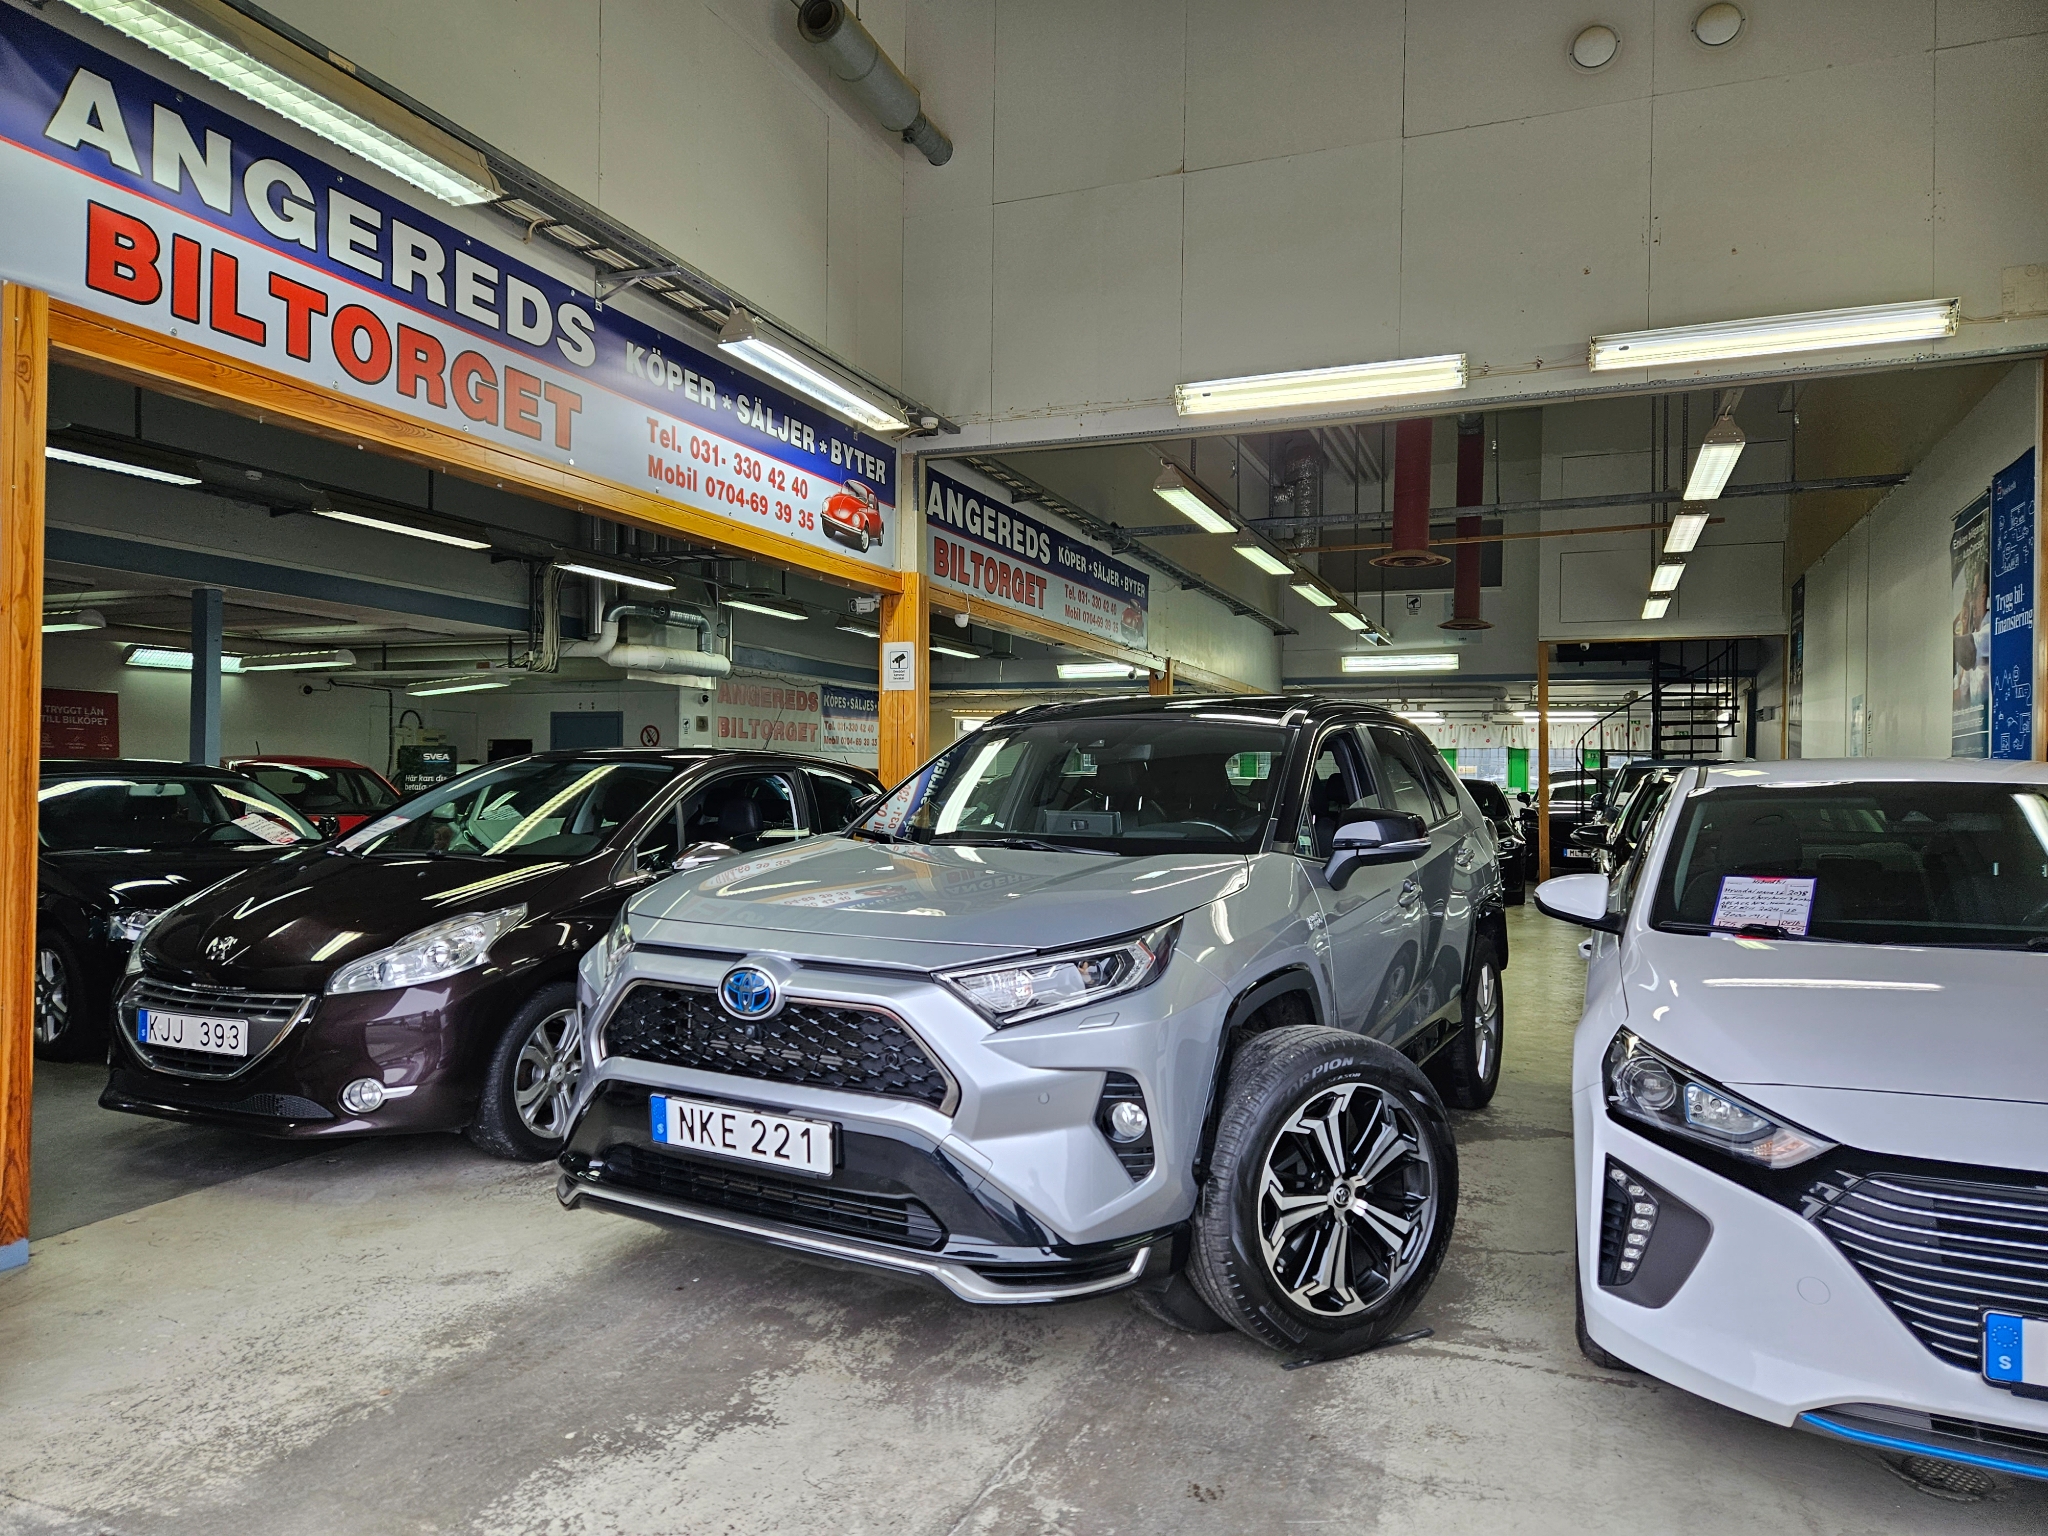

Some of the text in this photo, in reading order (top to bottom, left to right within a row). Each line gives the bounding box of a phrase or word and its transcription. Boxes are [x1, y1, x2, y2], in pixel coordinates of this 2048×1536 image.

[43, 66, 597, 368] ANGEREDS
[86, 199, 582, 452] BILTORGET
[625, 340, 887, 486] KÖPER SÄLJER BYTER
[646, 416, 809, 500] Tel. 031- 330 42 40
[647, 454, 815, 531] Mobil 0704-69 39 35
[926, 480, 1051, 565] ANGEREDS
[934, 536, 1047, 610] BILTORGET
[1058, 545, 1146, 599] KÖPER SÄLJER BYTER
[1065, 584, 1076, 600] Tel.
[1092, 591, 1102, 611] 330
[1103, 597, 1110, 613] 42
[1995, 592, 2014, 614] Trygg
[1064, 604, 1081, 622] Mobil
[1104, 617, 1112, 631] 39
[1994, 607, 2034, 635] finansiering
[44, 705, 104, 717] TRYGGT LÅN
[717, 681, 819, 713] ANGEREDS
[40, 714, 109, 726] TILL BILKÖPET
[717, 715, 819, 743] BILTORGET
[423, 752, 450, 760] SVEA
[405, 774, 417, 782] Här
[418, 774, 434, 782] kan
[149, 1015, 183, 1044] KJJ
[200, 1021, 239, 1050] 393
[1286, 1057, 1354, 1098] ORPION
[656, 1106, 811, 1164] S NKE 221
[1998, 1355, 2012, 1370] S
